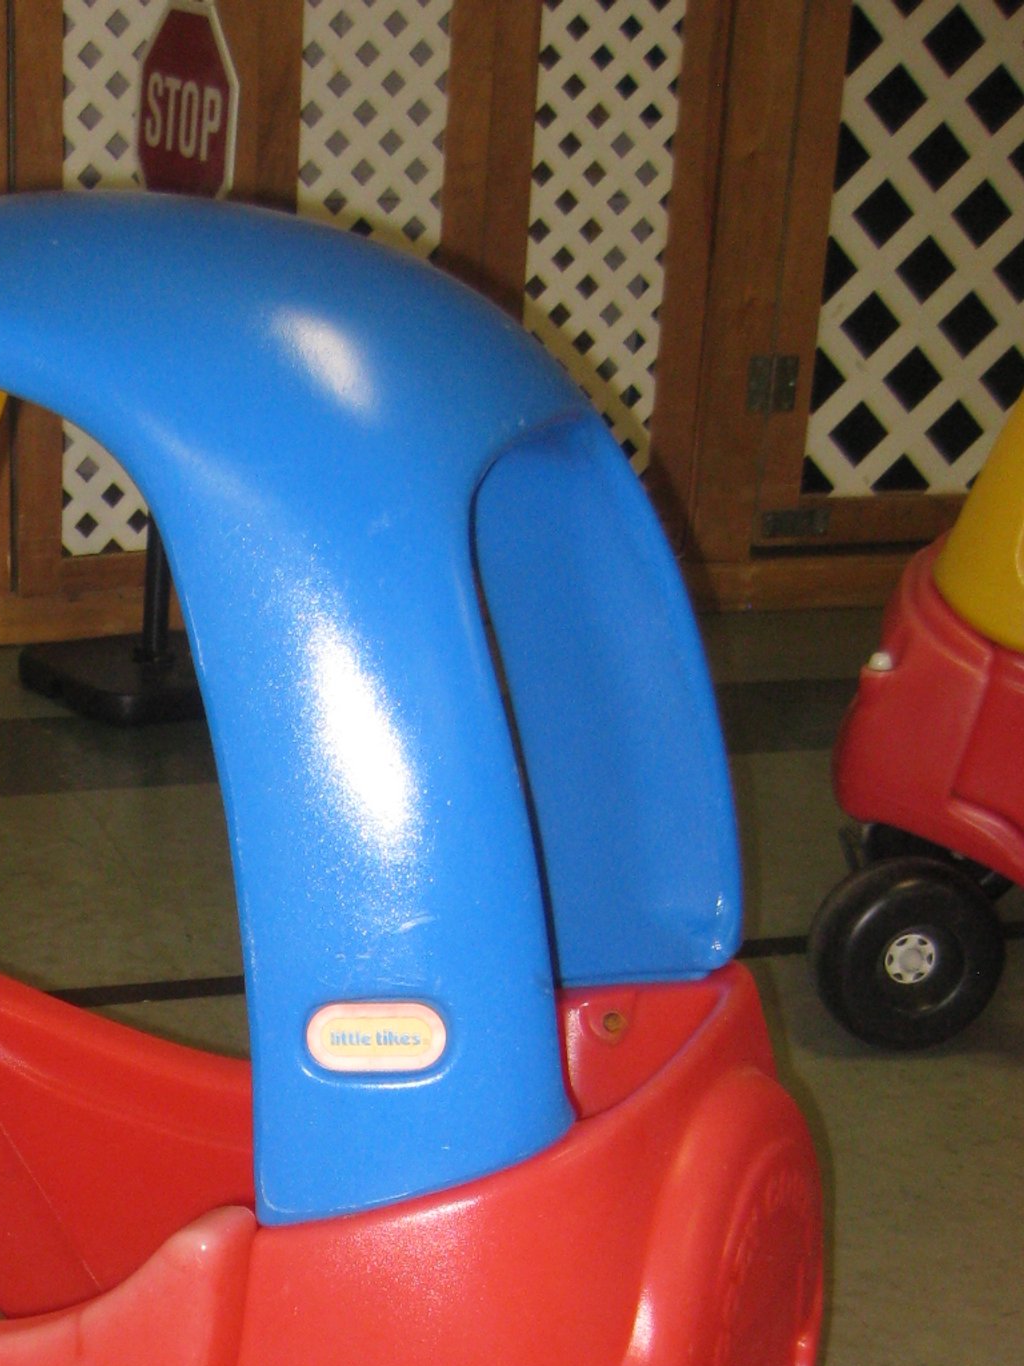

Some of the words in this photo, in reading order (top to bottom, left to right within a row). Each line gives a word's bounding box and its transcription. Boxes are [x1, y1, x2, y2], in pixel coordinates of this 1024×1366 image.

[145, 72, 222, 162] STOP
[331, 1031, 372, 1046] little
[376, 1030, 421, 1046] tikes
